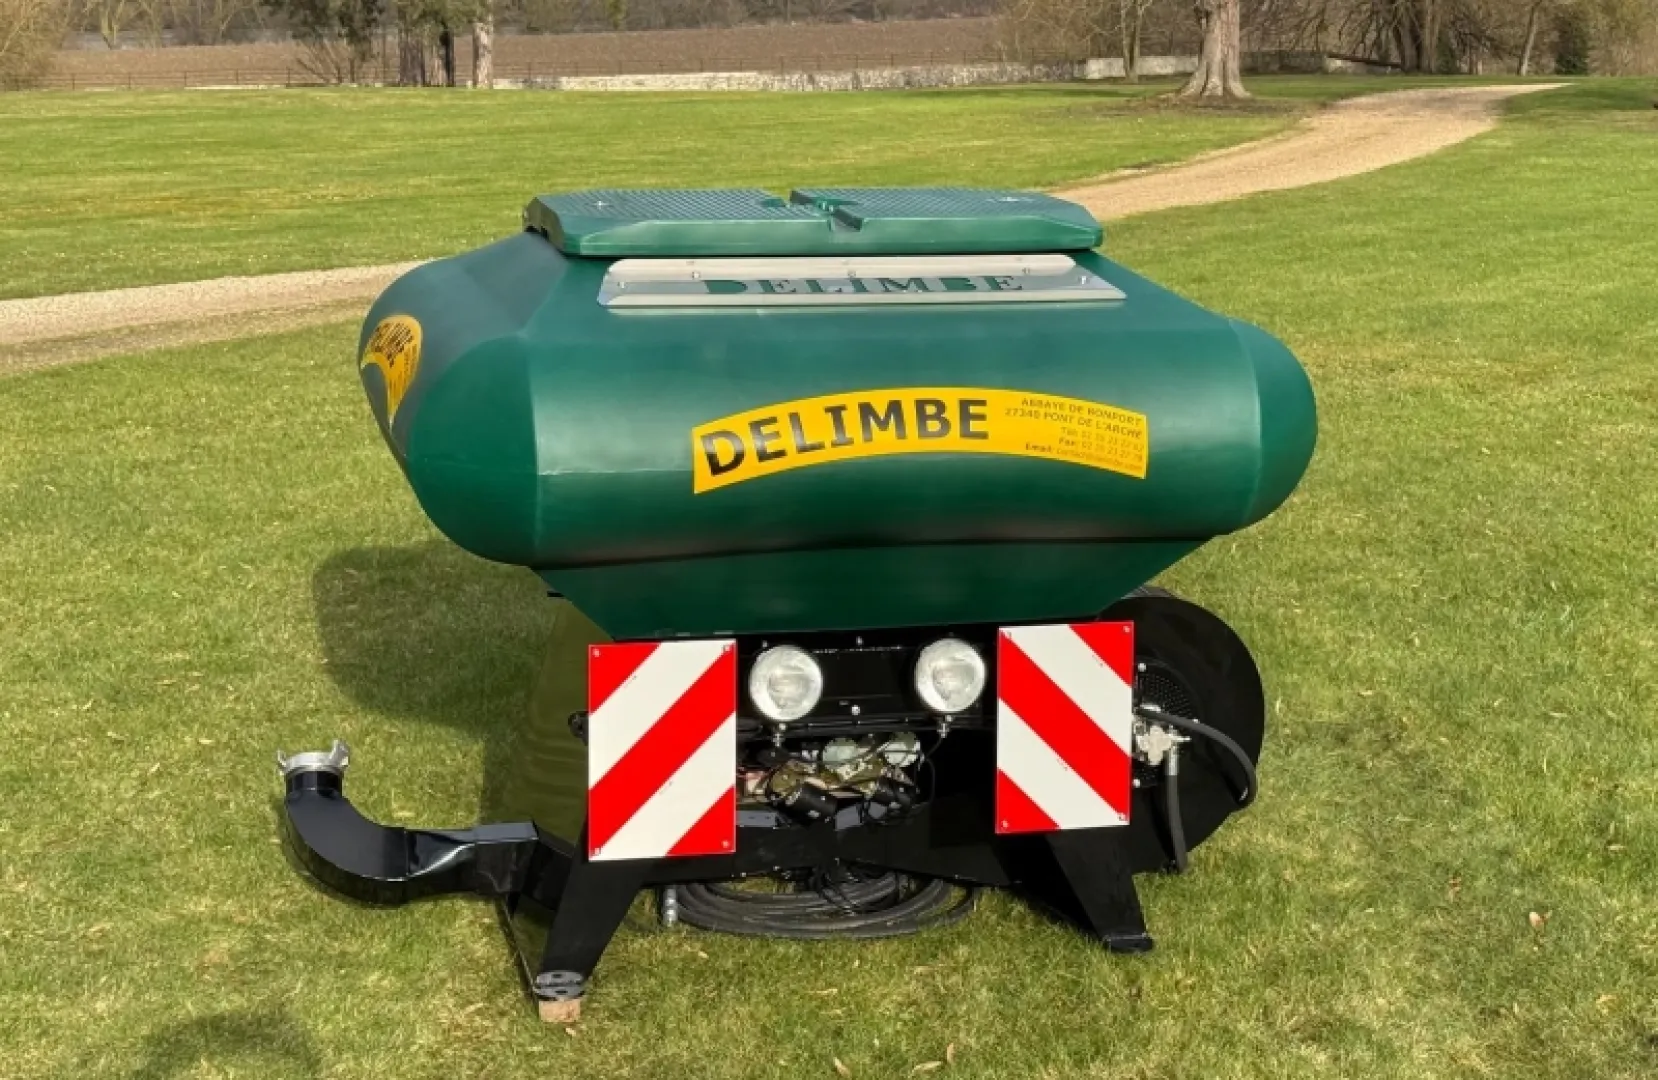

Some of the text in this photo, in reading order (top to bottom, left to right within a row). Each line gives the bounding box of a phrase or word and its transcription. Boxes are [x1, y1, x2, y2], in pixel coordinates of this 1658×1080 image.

[703, 275, 1024, 294] DELIMBE
[1021, 397, 1065, 411] ABBAYE
[1068, 404, 1084, 413] DE
[1044, 411, 1075, 424] PONT
[1077, 416, 1092, 427] DE
[1095, 420, 1142, 439] L'ARCHE
[700, 398, 989, 476] DELIMBE
